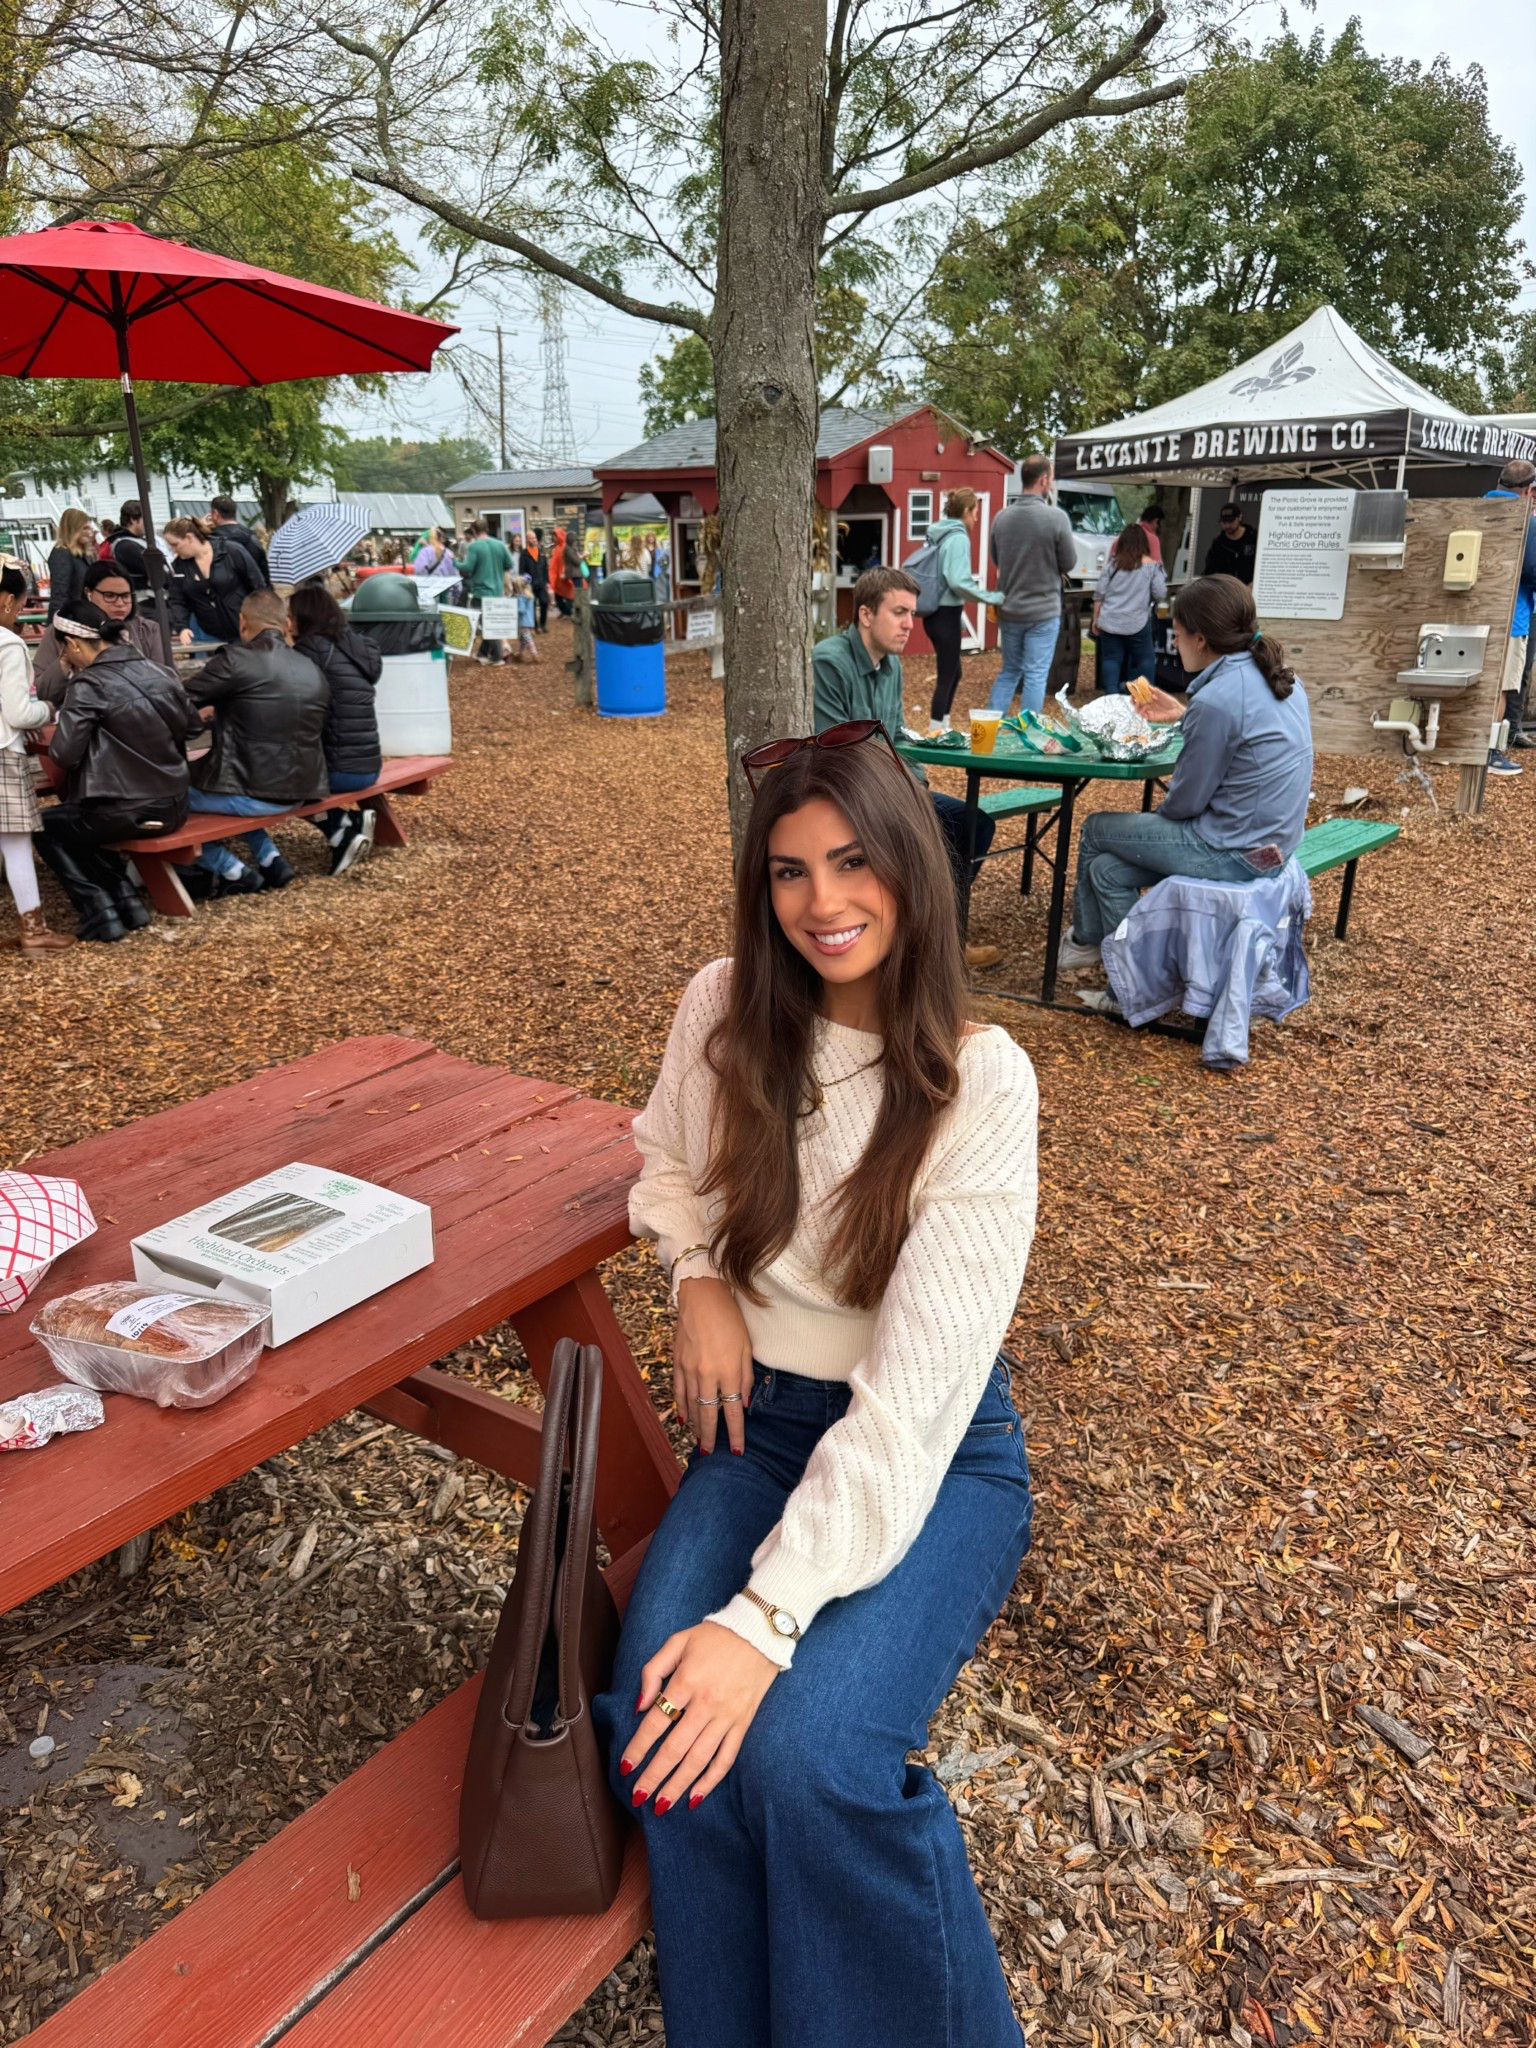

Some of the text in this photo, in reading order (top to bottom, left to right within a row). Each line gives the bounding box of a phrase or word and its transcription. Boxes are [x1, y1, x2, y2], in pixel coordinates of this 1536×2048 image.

[1076, 420, 1375, 471] LEVANTE BREWING CO.
[1420, 418, 1480, 454] LEVANTE
[1323, 496, 1349, 504] provided
[1267, 540, 1290, 548] Picnic
[1268, 531, 1341, 540] Highland Orchard's
[187, 1235, 242, 1258] Highland
[238, 1253, 290, 1276] Orchards
